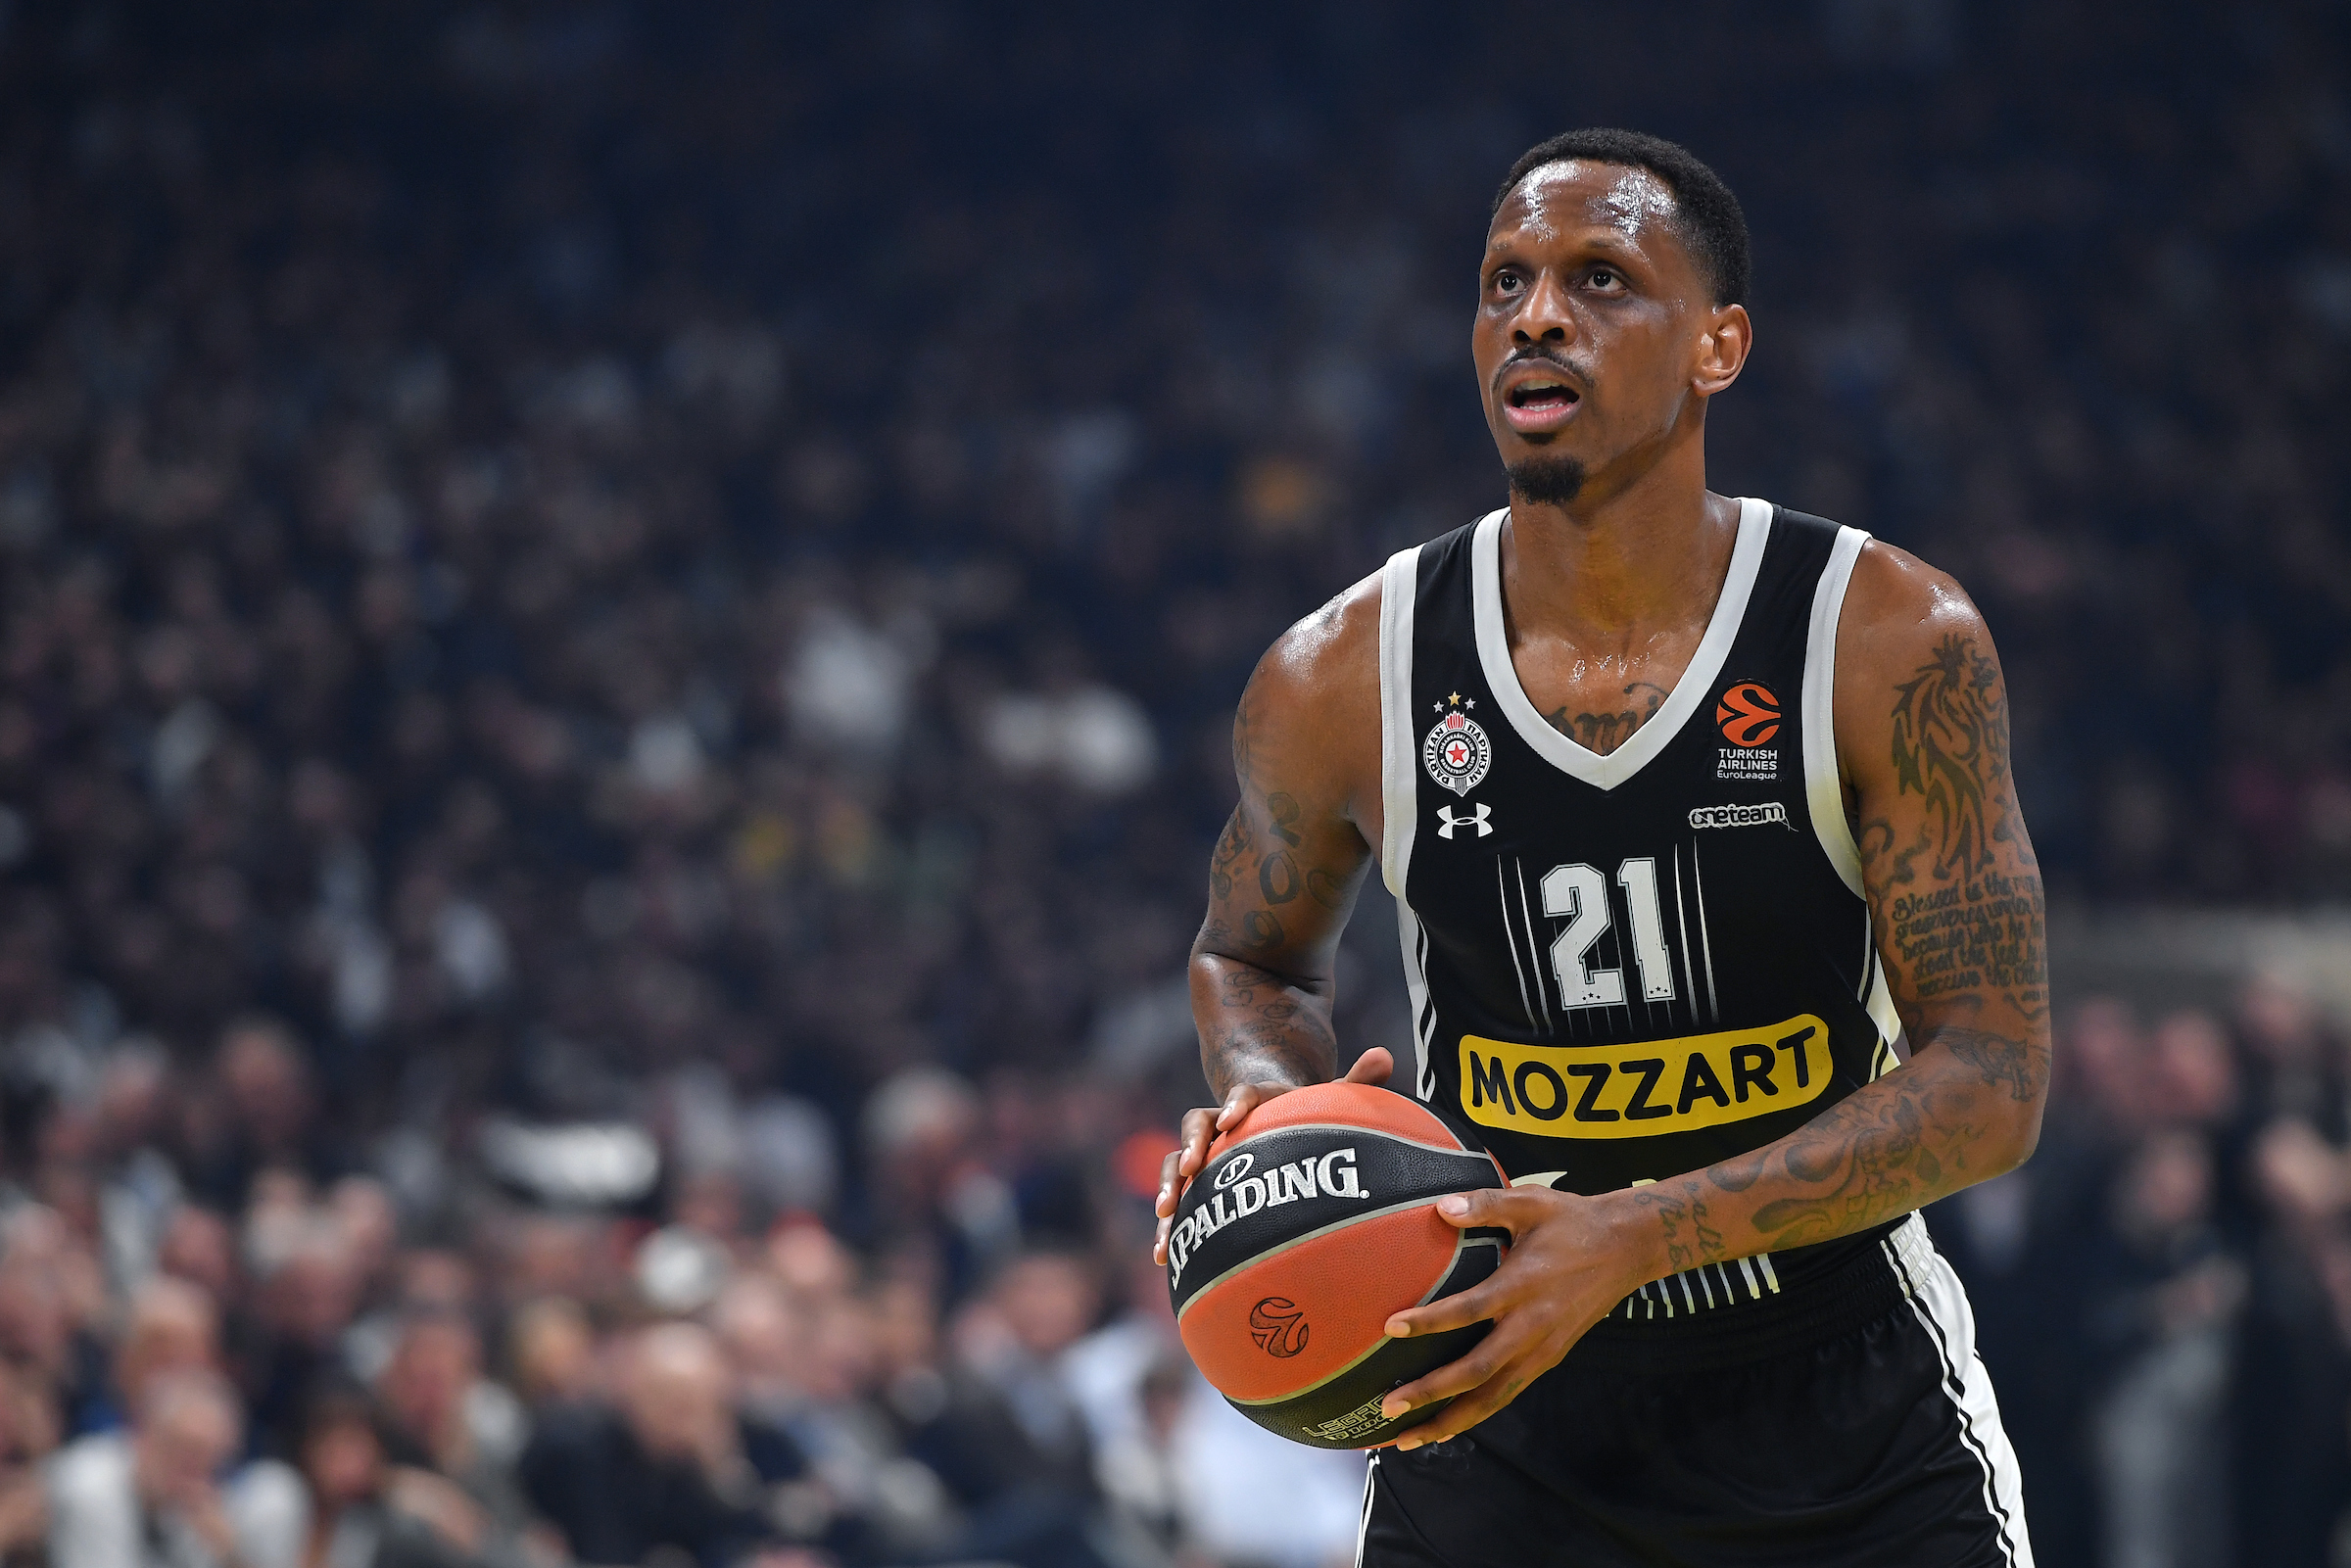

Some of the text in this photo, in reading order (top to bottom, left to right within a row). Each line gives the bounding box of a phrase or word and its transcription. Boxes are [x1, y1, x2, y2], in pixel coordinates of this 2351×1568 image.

[1426, 727, 1450, 784] PARTIZAN
[1467, 724, 1488, 784] ПАРТИЗАН
[1716, 770, 1778, 782] EuroLeague
[1717, 759, 1778, 771] AIRLINES
[1718, 748, 1778, 760] TURKISH
[1690, 803, 1786, 829] oneteam
[1540, 857, 1676, 1010] 21
[1469, 1025, 1815, 1122] MOZZART
[1168, 1148, 1360, 1292] SPALDING
[1302, 1379, 1404, 1437] LEGAC
